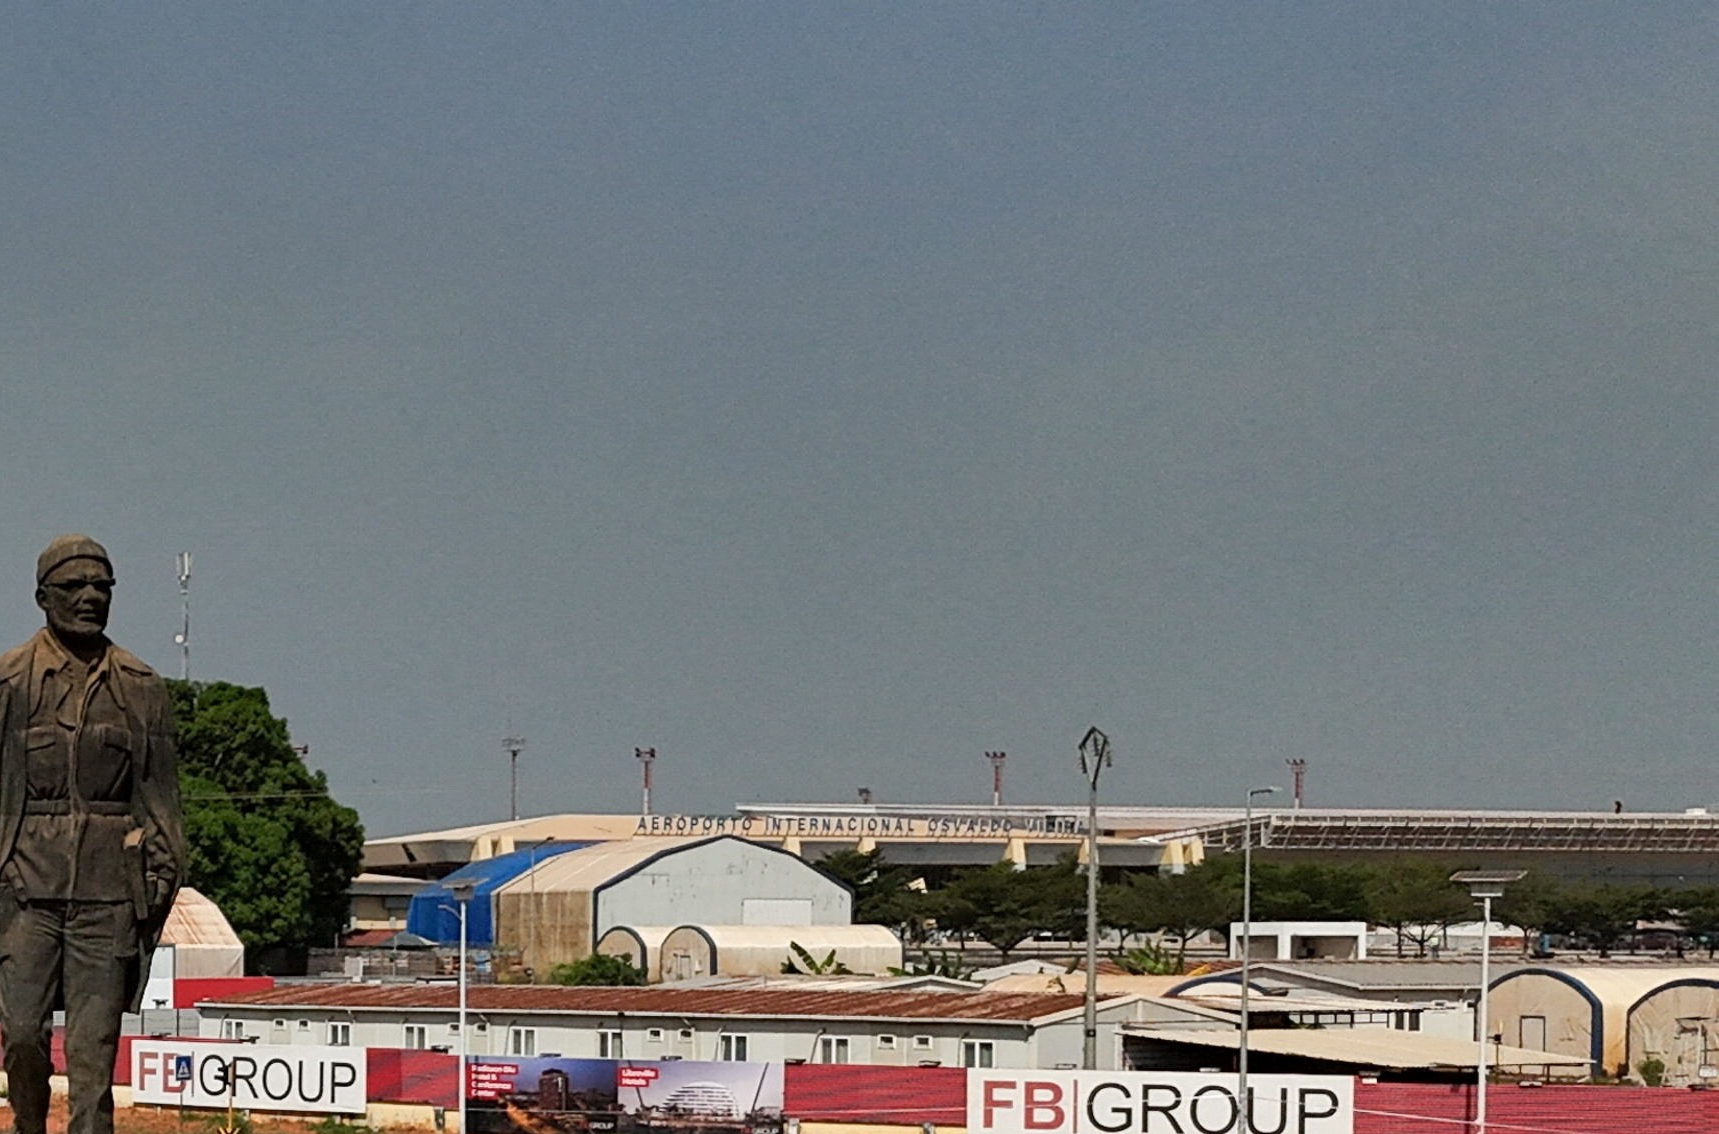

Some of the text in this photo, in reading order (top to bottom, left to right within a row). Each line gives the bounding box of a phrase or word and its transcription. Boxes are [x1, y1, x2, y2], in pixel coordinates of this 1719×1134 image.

[766, 817, 914, 832] INTERNACIONAL
[928, 818, 1012, 832] OSVALDO
[199, 1054, 357, 1103] GROUP
[983, 1080, 1065, 1130] FB
